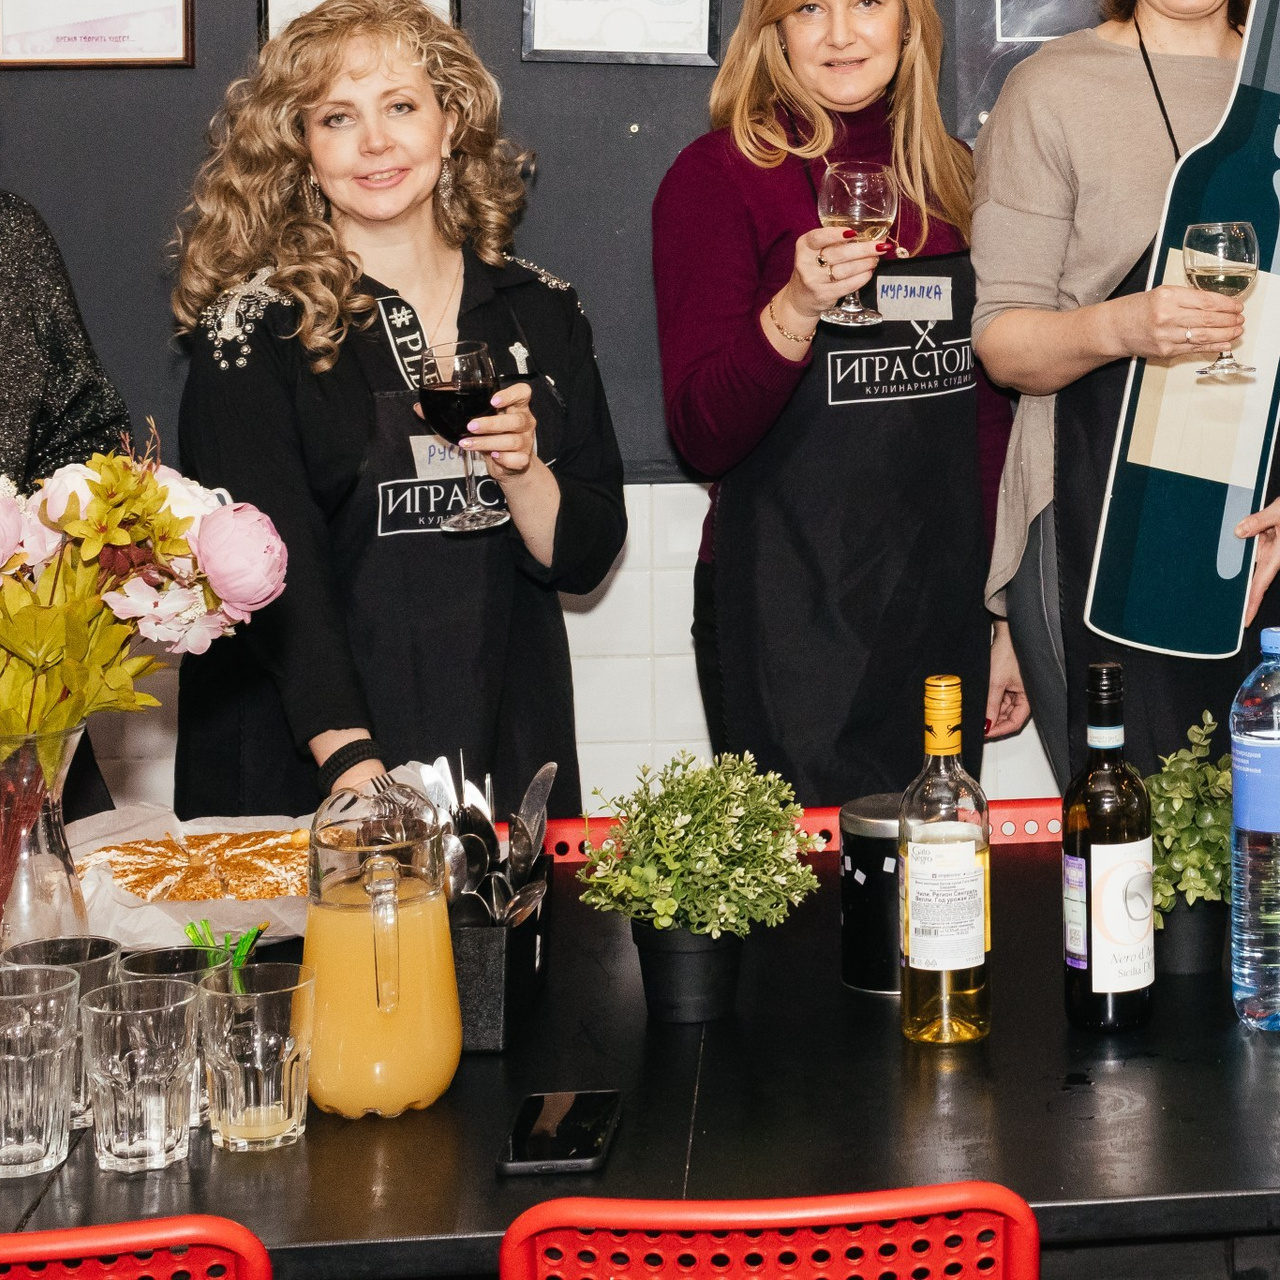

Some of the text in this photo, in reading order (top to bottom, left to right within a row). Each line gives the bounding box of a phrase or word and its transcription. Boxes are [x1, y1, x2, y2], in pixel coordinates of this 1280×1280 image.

[880, 283, 943, 301] МУРЗИЛКА
[836, 345, 974, 385] ИГРА СТОЛ
[865, 380, 939, 395] КУЛИНАРНАЯ
[387, 483, 468, 516] ИГРА
